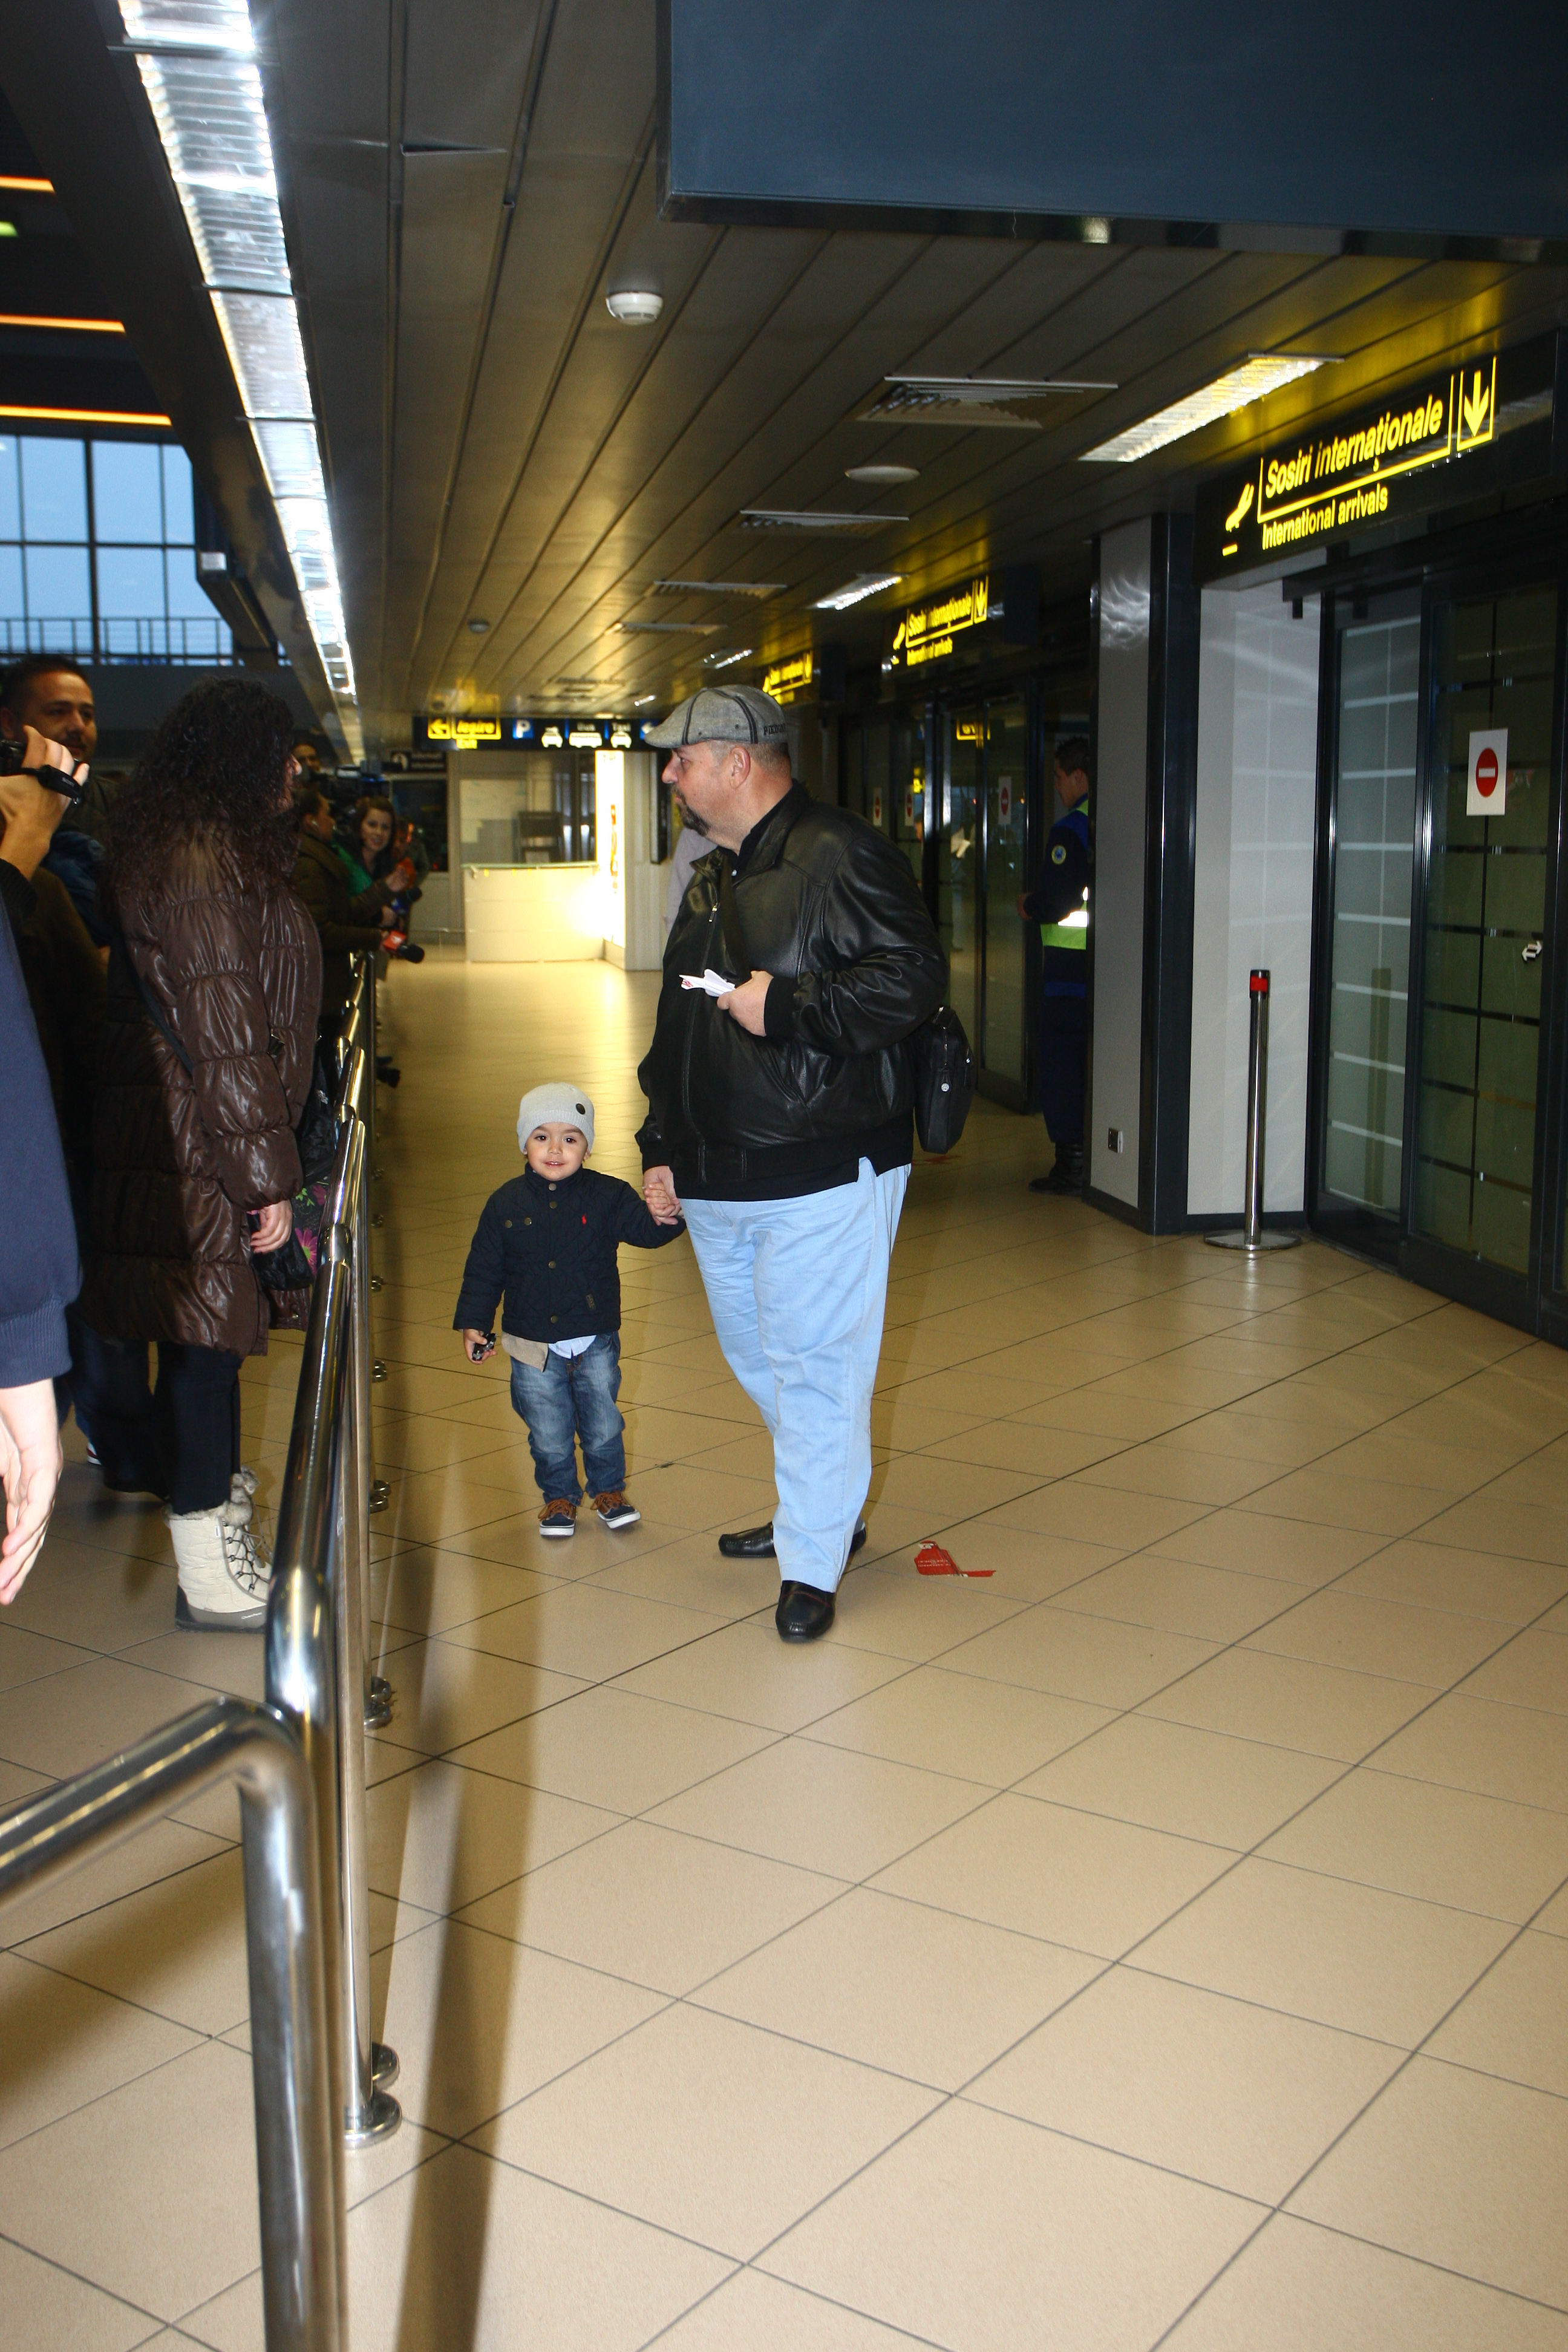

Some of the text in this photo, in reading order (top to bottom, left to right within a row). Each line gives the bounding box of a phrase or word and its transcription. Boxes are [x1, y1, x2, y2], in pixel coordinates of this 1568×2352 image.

[1265, 445, 1313, 498] Sosiri
[1262, 483, 1388, 550] International arrivals
[516, 719, 531, 738] P
